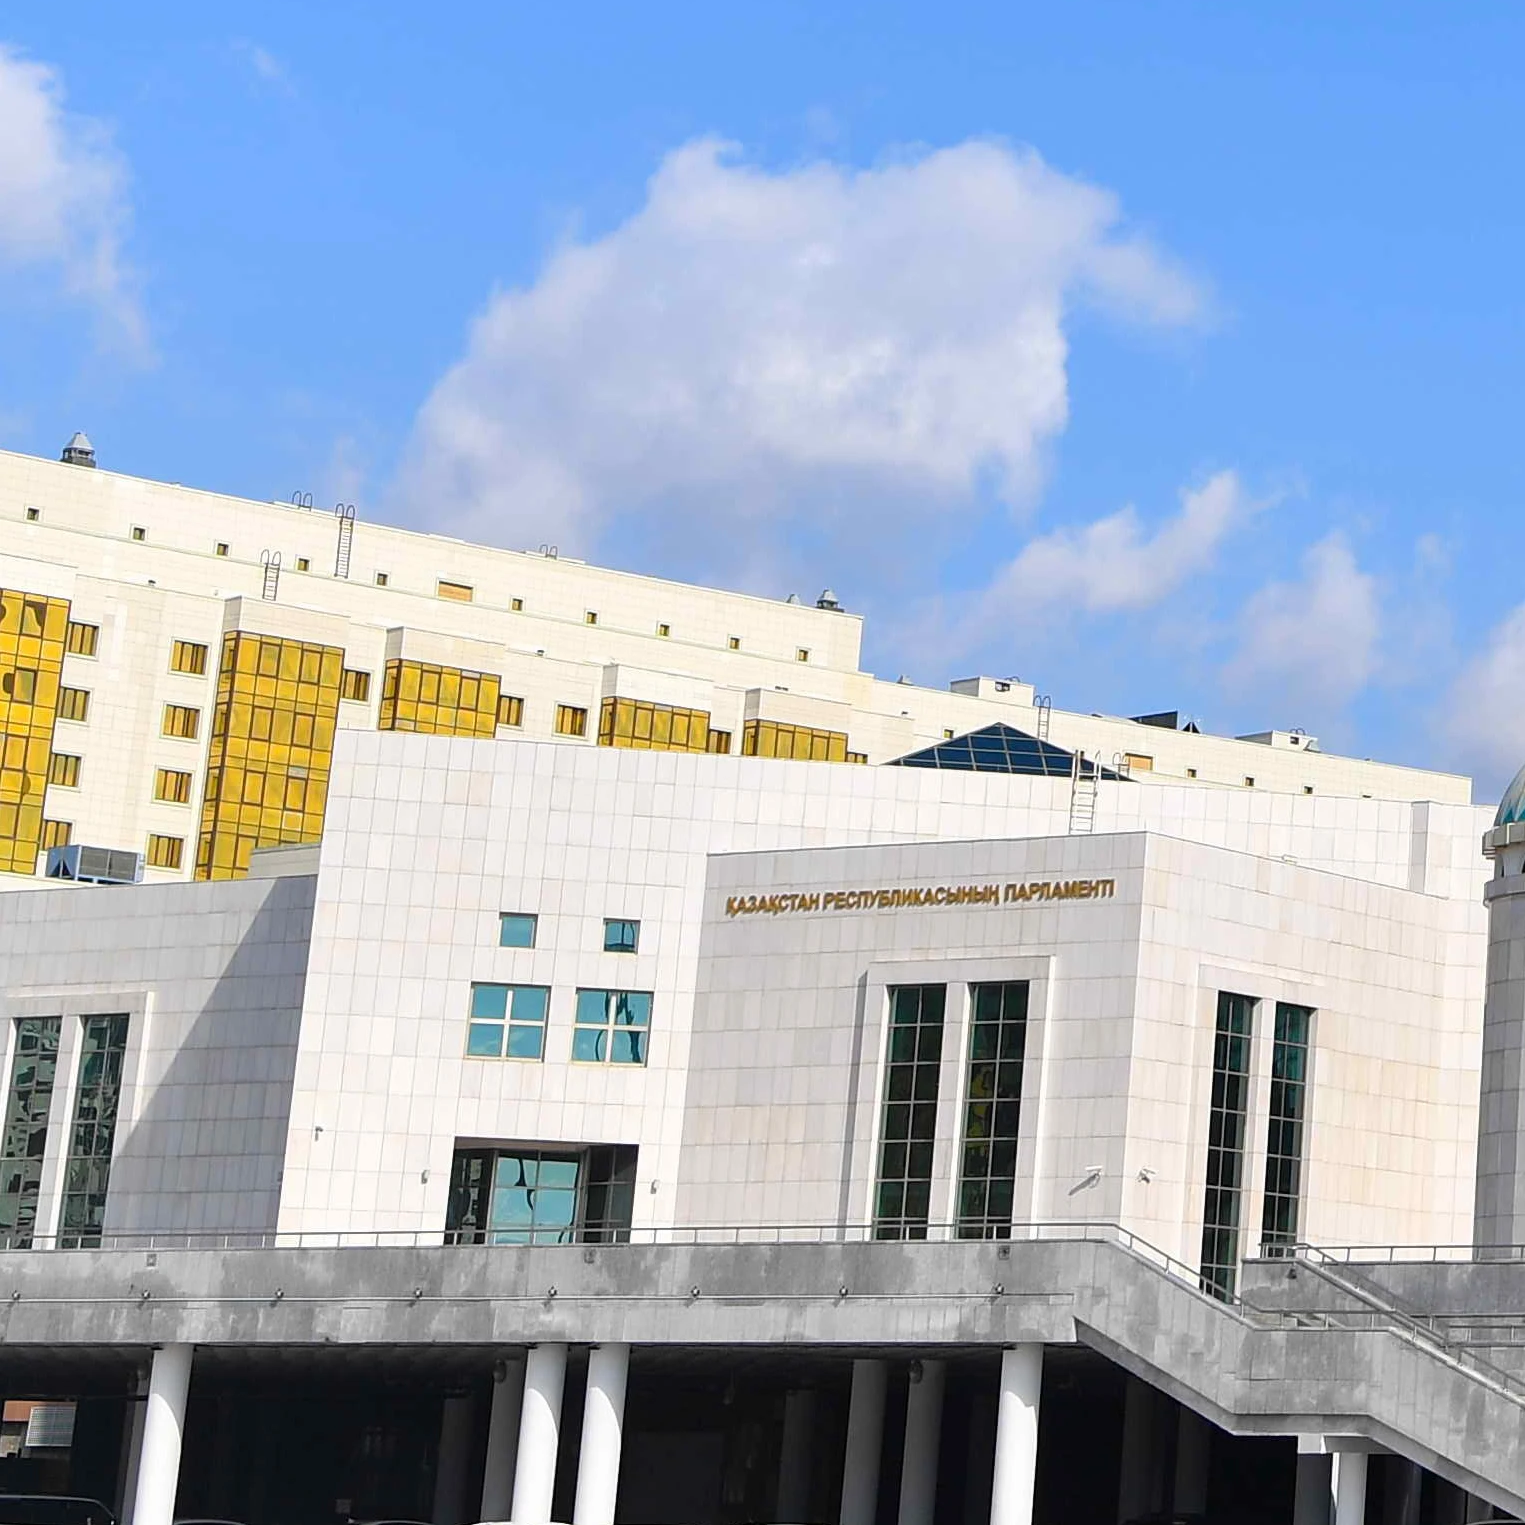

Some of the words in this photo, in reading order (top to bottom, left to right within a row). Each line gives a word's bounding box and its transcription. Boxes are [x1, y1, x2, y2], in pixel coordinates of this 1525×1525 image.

[726, 892, 820, 917] ҚАЗАҚСТАН
[822, 884, 999, 911] РЕСПУБЛИКАСЫНЫҢ
[1003, 879, 1115, 902] ПАРЛАМЕНТІ
